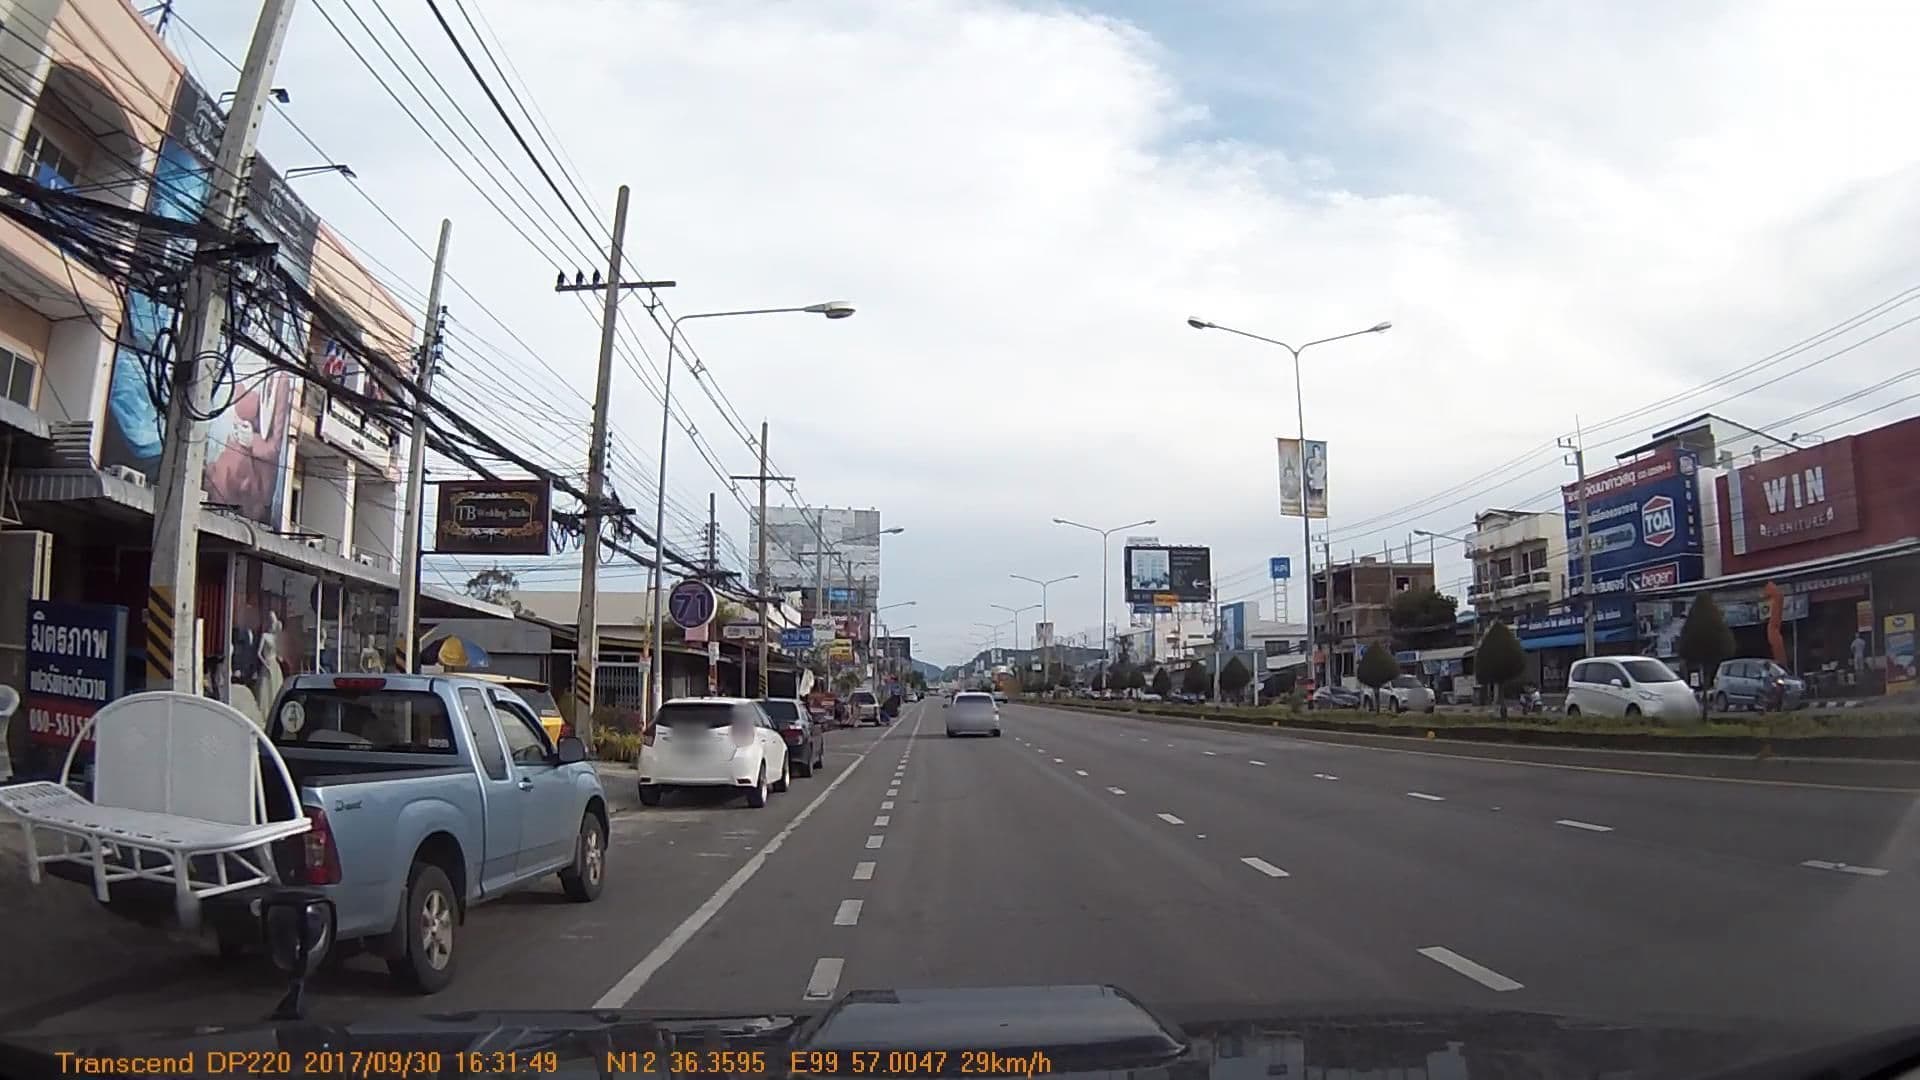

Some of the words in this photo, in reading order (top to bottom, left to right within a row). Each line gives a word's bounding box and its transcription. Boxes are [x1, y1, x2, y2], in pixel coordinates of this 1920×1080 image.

[1763, 466, 1825, 514] WIN
[1644, 509, 1672, 534] TOA
[673, 592, 707, 621] 71
[31, 610, 108, 659] มิตรภาพ
